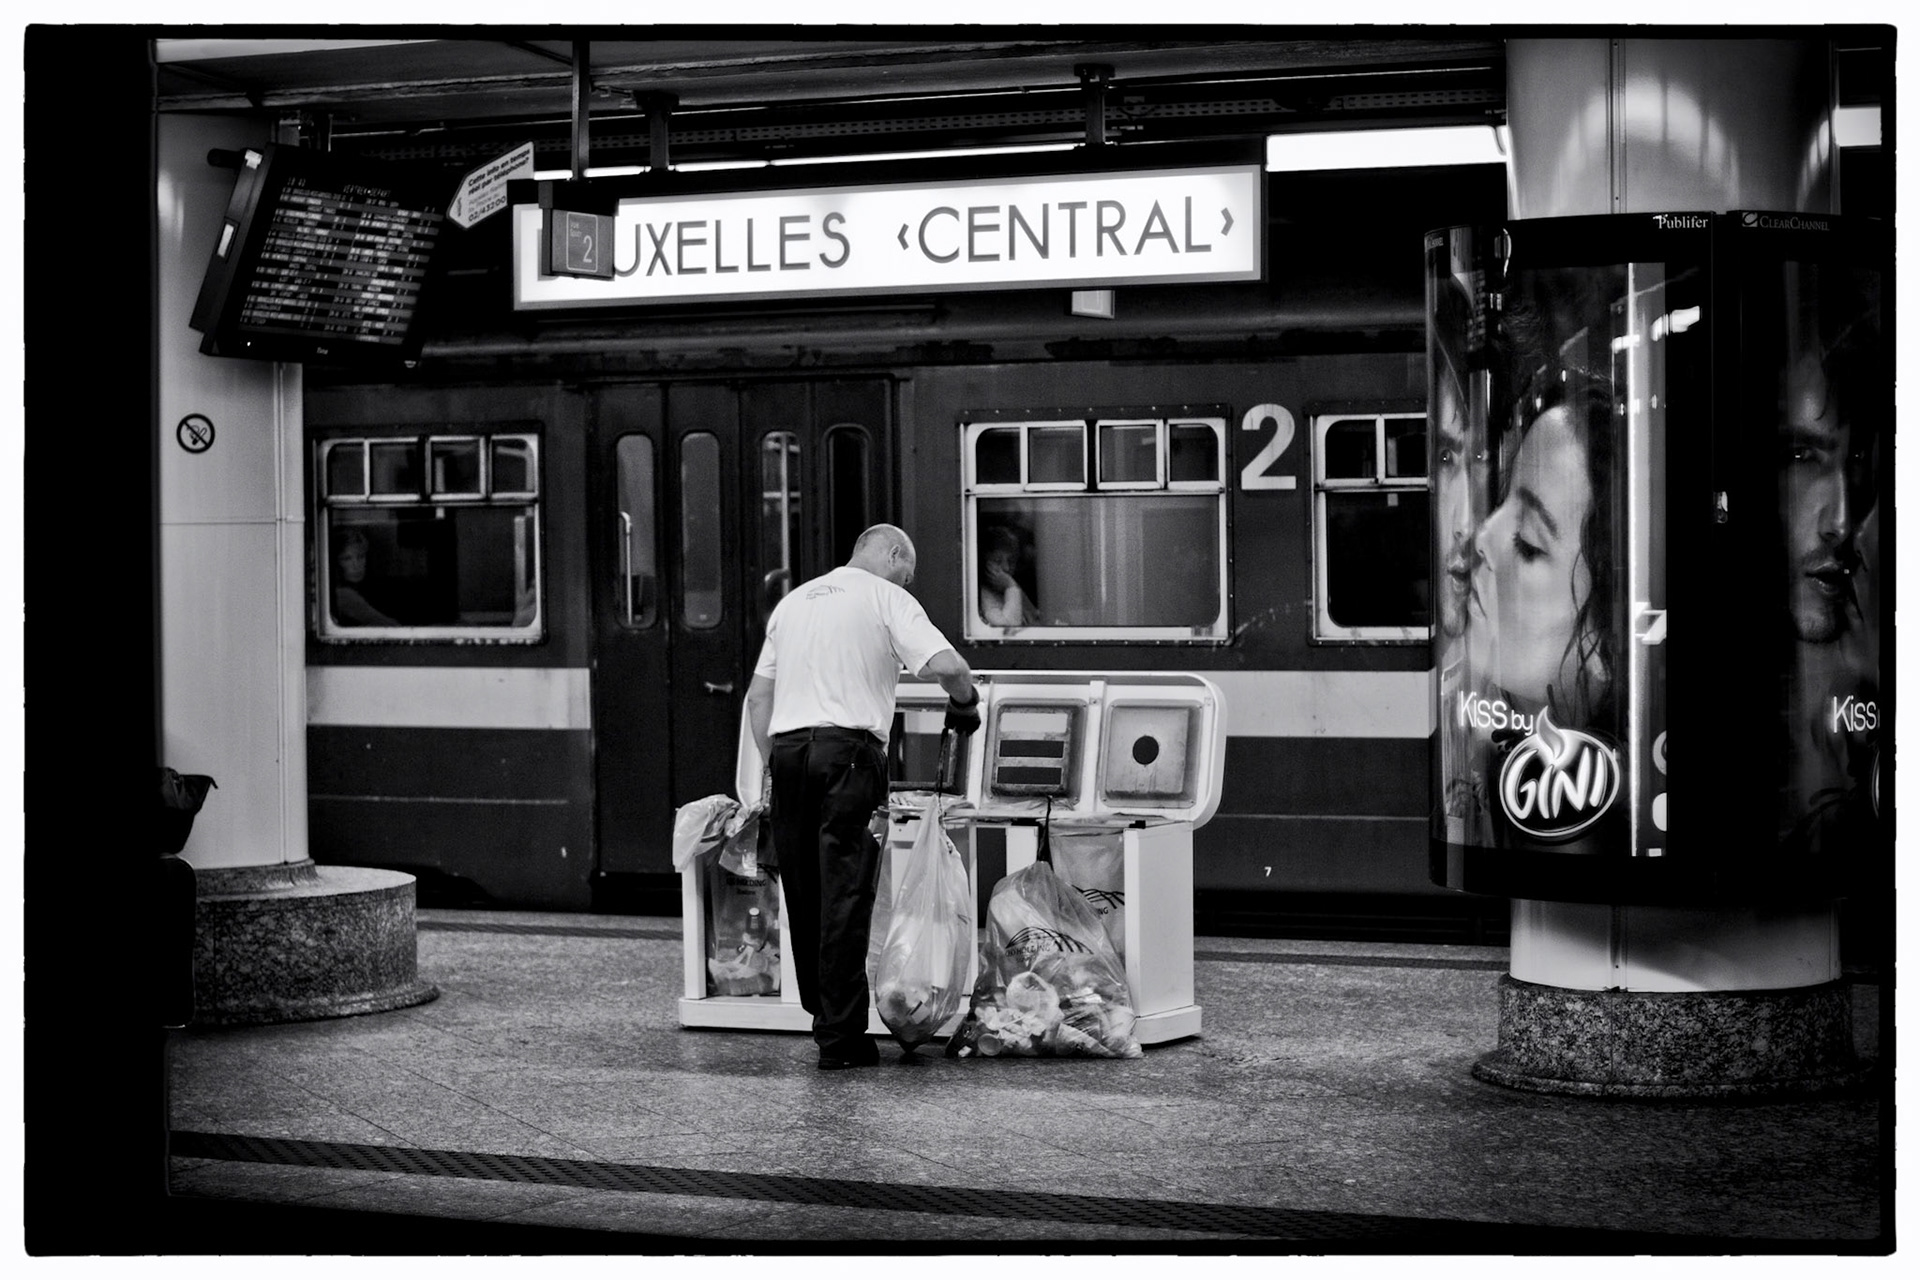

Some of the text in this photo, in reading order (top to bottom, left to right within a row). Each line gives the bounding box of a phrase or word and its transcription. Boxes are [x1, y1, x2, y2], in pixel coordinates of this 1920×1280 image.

[1653, 213, 1709, 230] Publifer
[582, 234, 593, 263] 2
[614, 211, 851, 278] UXELLES
[1241, 403, 1297, 490] 2
[1459, 690, 1534, 736] Kiss by
[1833, 694, 1877, 734] Kiss
[1264, 866, 1272, 878] 7
